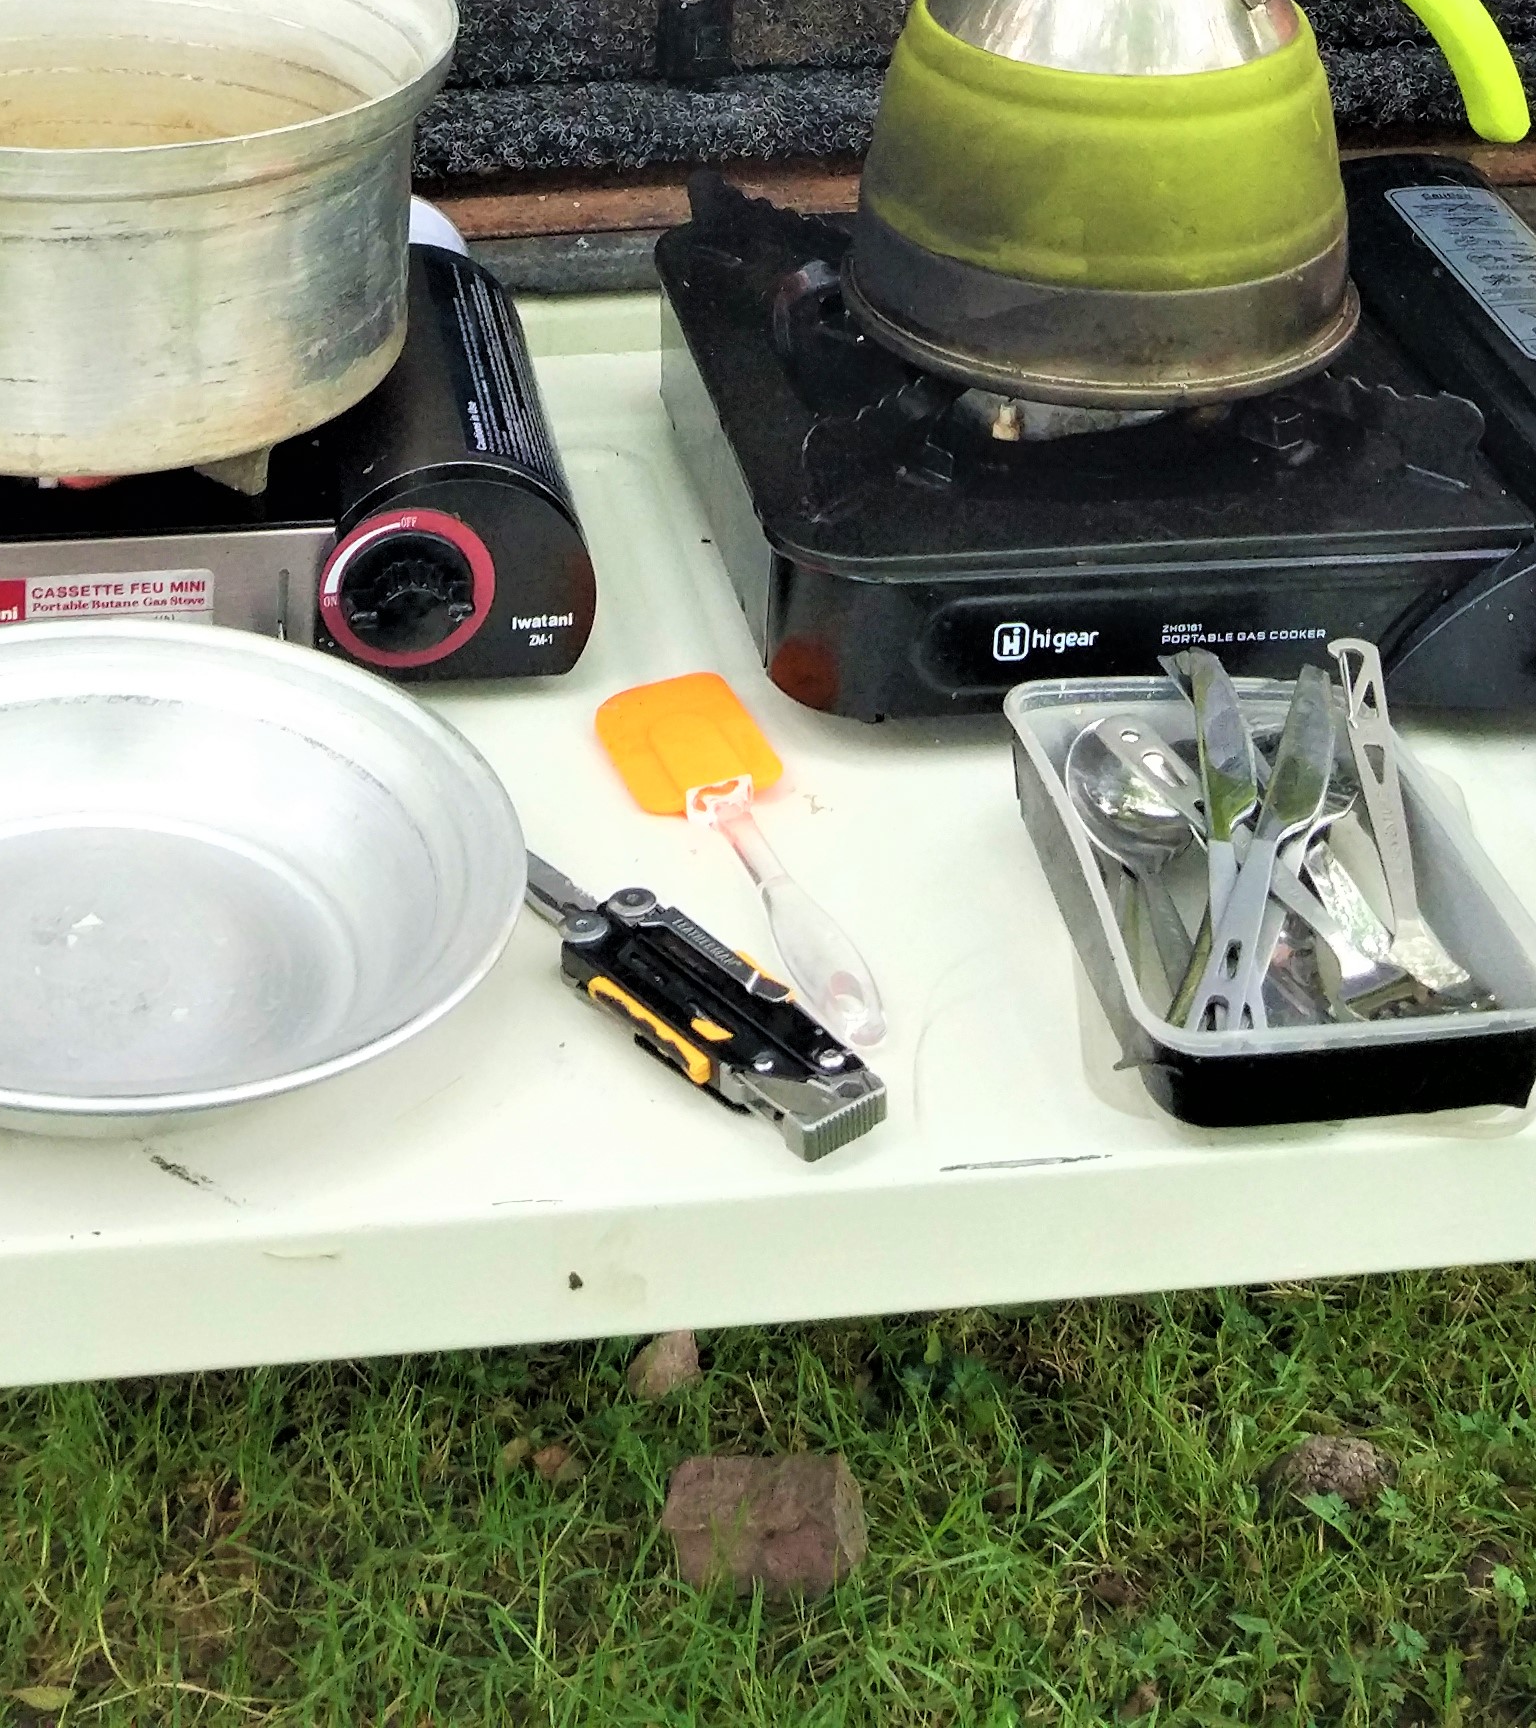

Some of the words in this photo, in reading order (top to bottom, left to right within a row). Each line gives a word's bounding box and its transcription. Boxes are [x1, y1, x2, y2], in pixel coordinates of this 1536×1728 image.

[400, 516, 418, 529] OFF
[31, 583, 124, 600] CASSETTE
[130, 581, 164, 595] FEU
[169, 580, 206, 594] MINI
[32, 599, 90, 613] Portable
[91, 597, 140, 611] Butane
[142, 596, 168, 608] Gas
[170, 595, 206, 607] Stove
[323, 596, 339, 608] ON
[511, 612, 574, 631] Iwatani
[527, 633, 554, 647] ZM-1
[1161, 632, 1234, 646] PORTABLE
[1237, 631, 1266, 643] GAS
[1269, 628, 1327, 641] COOKER
